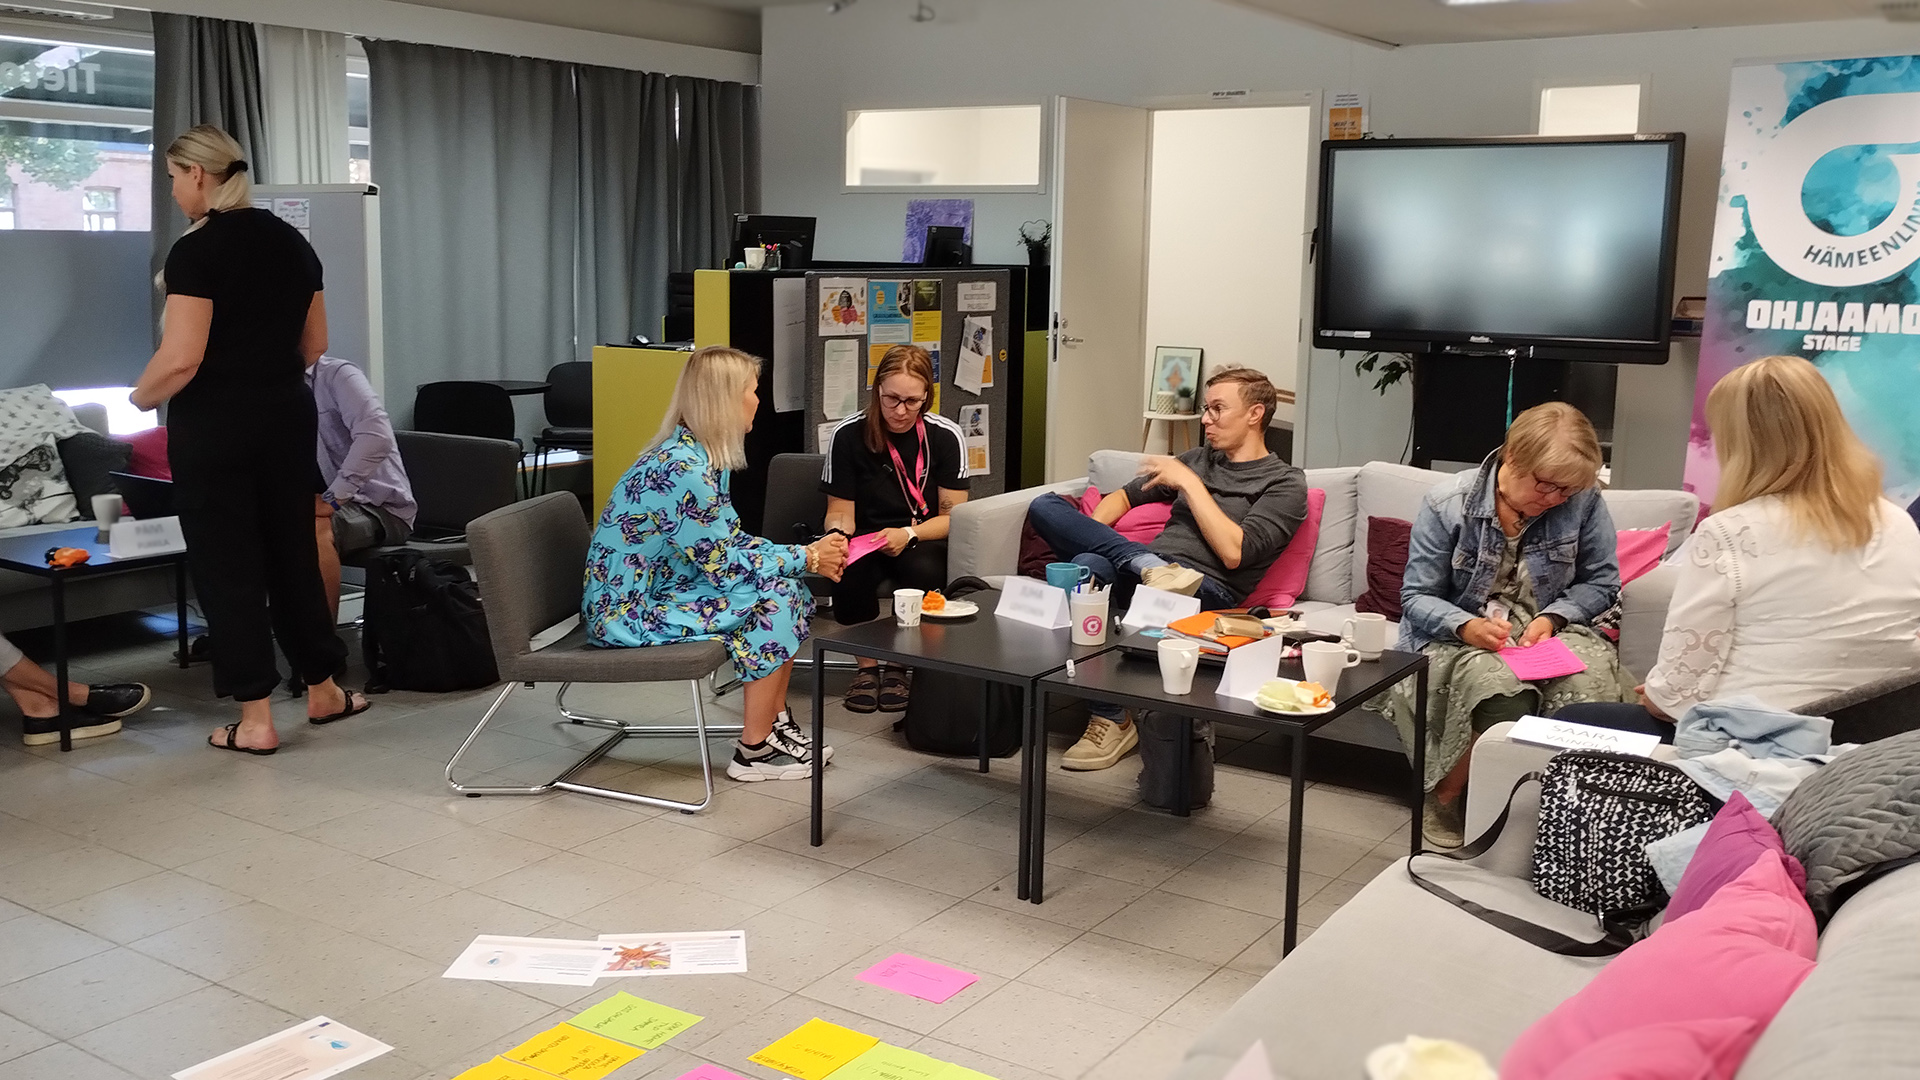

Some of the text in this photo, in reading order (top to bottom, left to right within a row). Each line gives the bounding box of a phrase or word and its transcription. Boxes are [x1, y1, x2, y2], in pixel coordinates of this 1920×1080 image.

[1746, 300, 1920, 334] OHJAAMO
[1802, 335, 1862, 352] STAGE
[1551, 724, 1619, 743] SAARA
